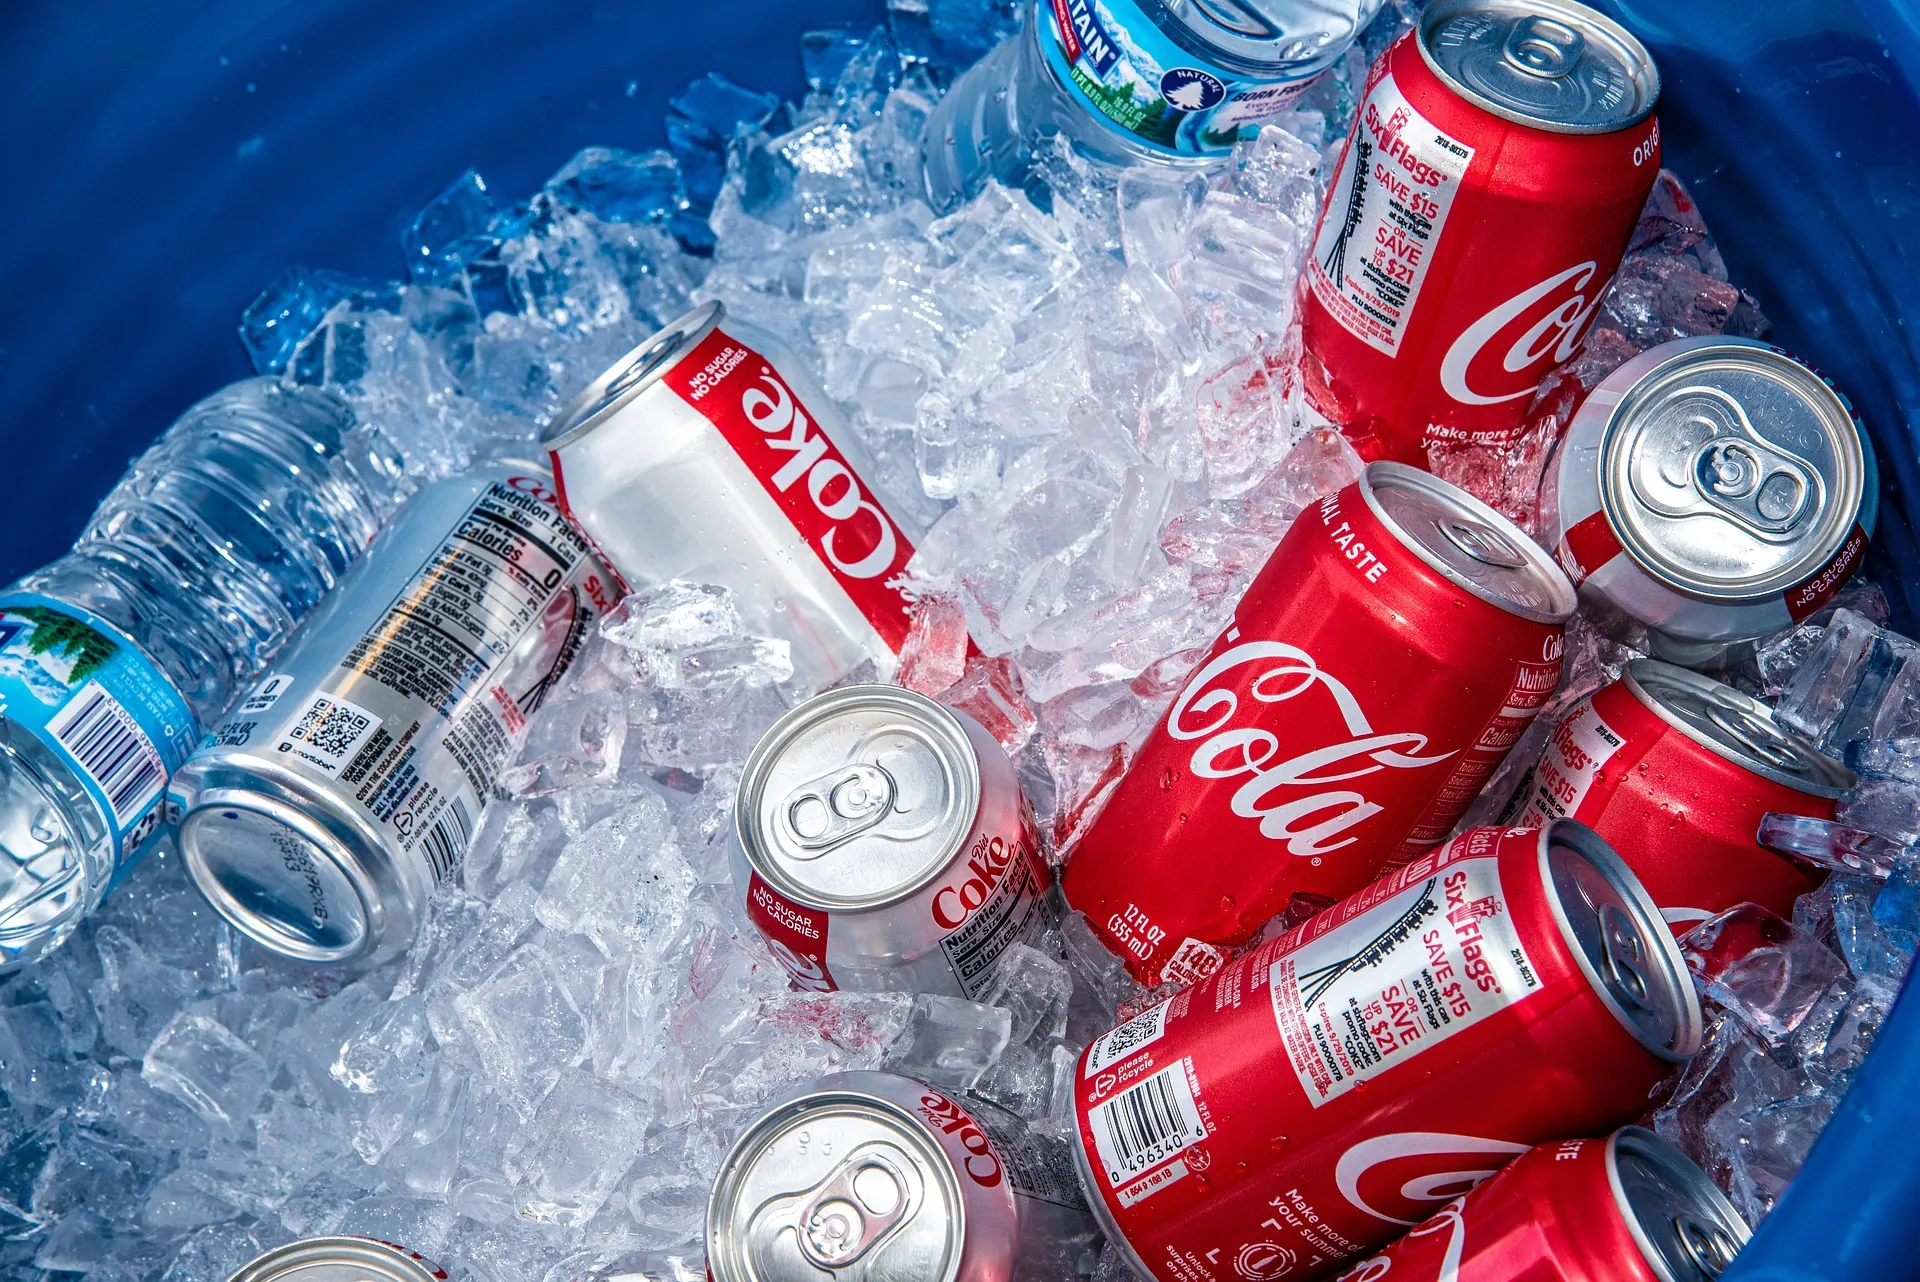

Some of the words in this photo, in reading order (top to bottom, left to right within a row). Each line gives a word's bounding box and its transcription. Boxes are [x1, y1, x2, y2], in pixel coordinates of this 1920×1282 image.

[1177, 71, 1220, 93] NATURAL
[1231, 89, 1278, 101] BORN
[1365, 103, 1384, 140] Six
[1390, 140, 1443, 188] Flags
[1374, 163, 1411, 203] SAVE
[1410, 193, 1440, 219] $15
[1375, 247, 1386, 258] UP
[1376, 227, 1422, 267] SAVE
[1394, 227, 1407, 240] OR
[1362, 270, 1386, 290] promo
[1373, 254, 1383, 267] TO
[1386, 258, 1415, 285] $21
[1352, 294, 1364, 309] PLU
[688, 372, 707, 388] NO
[704, 347, 735, 375] SUGAR
[690, 384, 710, 400] NO
[707, 348, 748, 386] CALORIES
[1426, 423, 1467, 440] Make
[1471, 429, 1509, 440] more
[741, 374, 896, 580] Coke
[479, 499, 507, 514] Serv.
[509, 511, 533, 528] Size
[556, 543, 577, 563] Can
[487, 483, 551, 521] Nutrition
[551, 516, 587, 552] Facts
[457, 521, 524, 561] Calories
[543, 568, 562, 589] 0
[1331, 521, 1388, 583] TASTE
[1796, 592, 1815, 607] NO
[1818, 537, 1861, 592] CALORIES
[1803, 580, 1820, 595] NO
[1822, 541, 1854, 581] SUGAR
[583, 575, 609, 613] Six
[263, 679, 280, 695] 0
[106, 697, 137, 731] 00013
[368, 770, 381, 785] THE
[377, 745, 403, 776] COCA-COLA
[399, 721, 422, 748] COMPANY
[1167, 641, 1460, 856] Cola
[1559, 729, 1588, 771] Flags
[408, 781, 430, 811] please
[1538, 755, 1560, 787] SAVE
[1554, 777, 1577, 804] $15
[414, 787, 439, 817] recycle
[972, 834, 989, 860] Diet
[932, 837, 1012, 929] Coke
[946, 896, 1003, 950] Nutrition
[1002, 851, 1024, 895] Facts
[1444, 871, 1467, 911] Six
[753, 888, 765, 907] NO
[767, 906, 820, 940] CALORIES
[760, 887, 773, 904] NO
[775, 902, 812, 928] SUGAR
[1124, 903, 1139, 923] 12
[1134, 913, 1149, 934] FL
[1147, 926, 1166, 946] OZ
[952, 938, 981, 958] Serv.
[983, 914, 1002, 935] Size
[961, 922, 1018, 977] Calories
[1108, 914, 1133, 942] (355
[1128, 937, 1154, 960] mL)
[1423, 929, 1455, 983] SAVE
[1442, 982, 1472, 1018] $15
[1455, 922, 1497, 993] Flags
[1348, 997, 1358, 1007] at
[1412, 979, 1422, 990] at
[1416, 989, 1428, 1005] Six
[1421, 968, 1434, 990] with
[1430, 988, 1442, 1008] this
[1438, 1006, 1451, 1025] can
[1342, 1011, 1360, 1041] promo
[1371, 1000, 1382, 1015] UP
[1381, 985, 1421, 1046] SAVE
[1406, 997, 1419, 1014] OR
[1424, 1003, 1440, 1030] Flags
[1318, 1002, 1333, 1040] Expires
[1329, 1033, 1354, 1077] 9/29/2019
[1352, 1006, 1382, 1063] sixflags.com
[1362, 1004, 1374, 1020] TO
[1370, 1020, 1399, 1056] $21
[1117, 1052, 1150, 1076] please
[1118, 1059, 1154, 1084] recycle
[1312, 1023, 1325, 1041] PLU
[1319, 1040, 1343, 1082] 90000178
[917, 1107, 943, 1128] Diet
[1198, 1101, 1207, 1112] 12
[1202, 1111, 1212, 1123] FL
[920, 1091, 1002, 1188] Coke
[1206, 1122, 1217, 1134] OZ
[1111, 1170, 1120, 1184] 0
[1129, 1134, 1183, 1173] 496340
[1196, 1125, 1204, 1137] 6
[1268, 1196, 1304, 1228] your
[1300, 1226, 1349, 1260] summer
[1285, 1188, 1320, 1224] Make
[1317, 1223, 1349, 1247] more
[1347, 1242, 1366, 1256] of
[1166, 1260, 1177, 1272] on
[1185, 1251, 1212, 1277] Unlock
